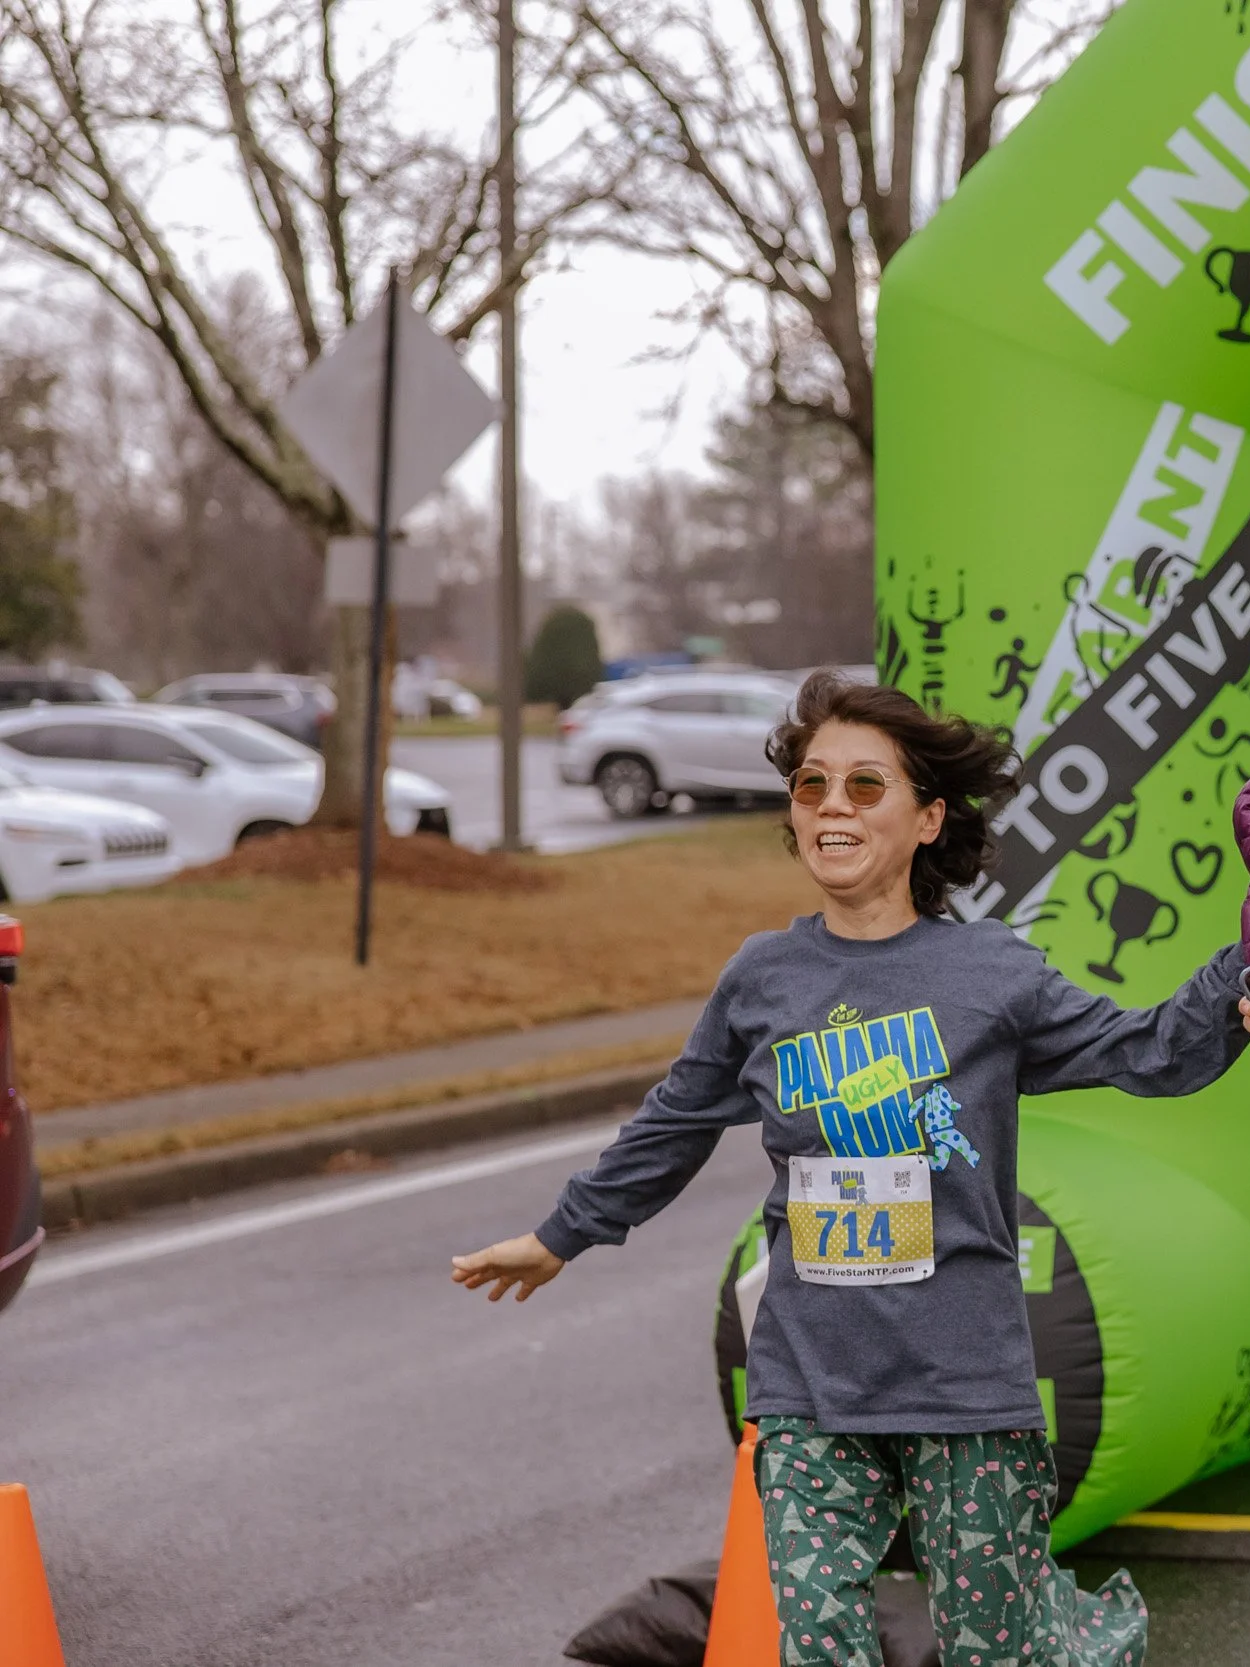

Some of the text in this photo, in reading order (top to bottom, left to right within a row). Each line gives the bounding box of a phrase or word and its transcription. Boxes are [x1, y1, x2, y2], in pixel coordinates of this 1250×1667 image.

[993, 744, 1109, 853] TO
[773, 1008, 949, 1112] PAJAMA
[843, 1059, 900, 1106] UGLY
[817, 1088, 924, 1157] RUN
[815, 1210, 896, 1258] 714
[806, 1265, 915, 1277] www.FiveStarNTP.com
